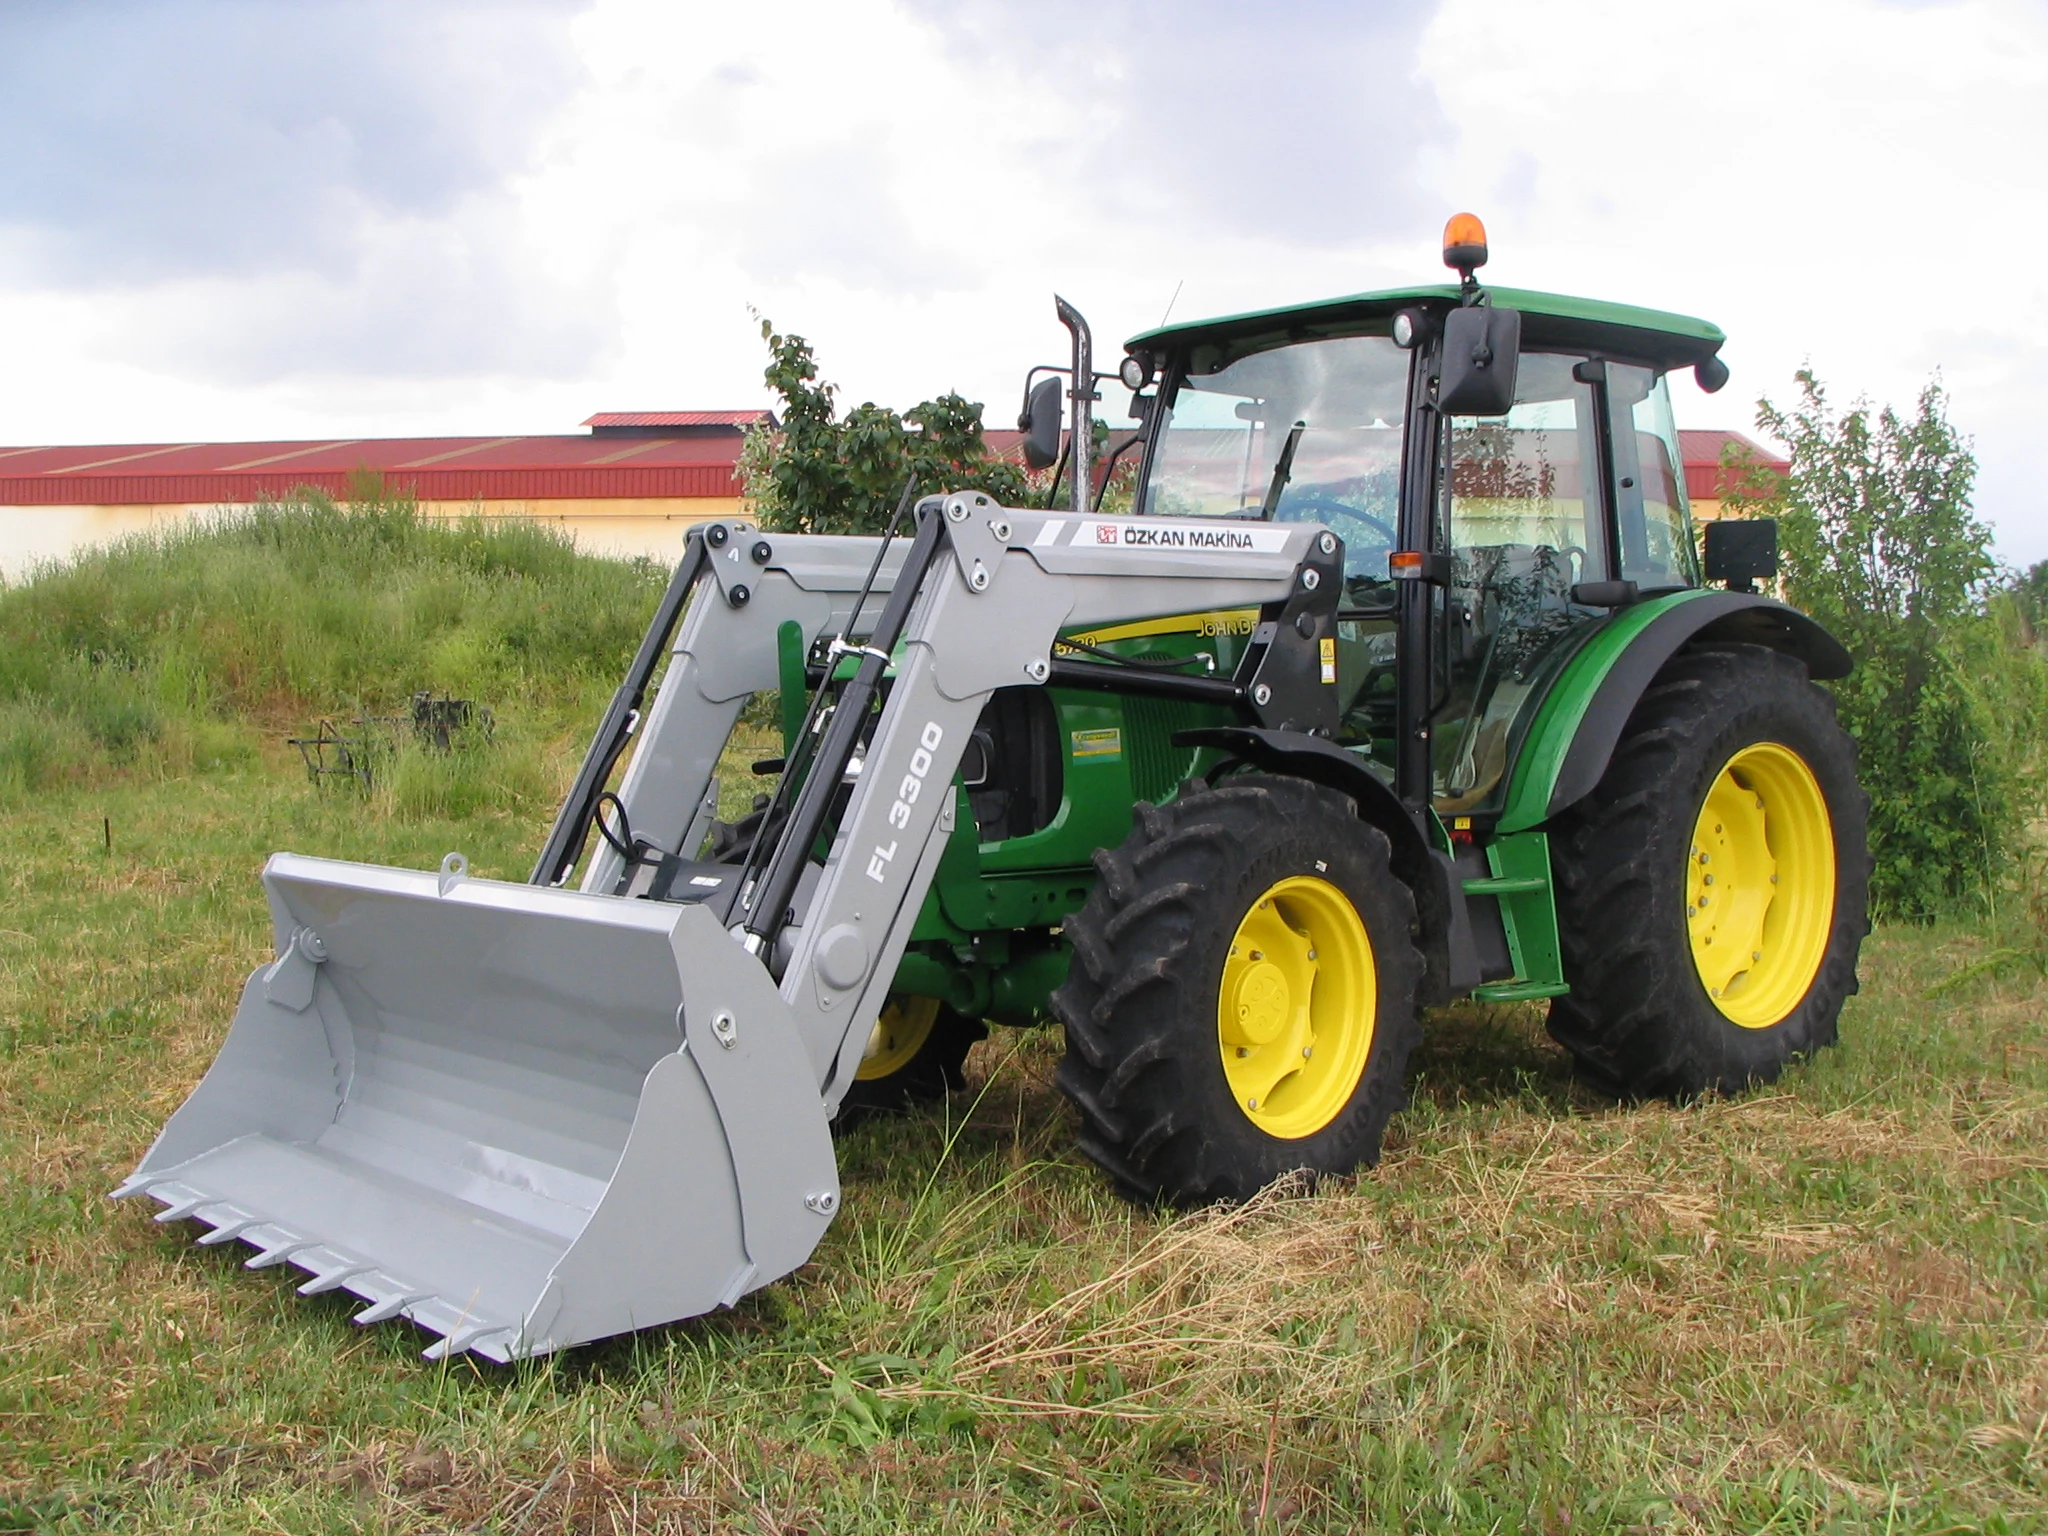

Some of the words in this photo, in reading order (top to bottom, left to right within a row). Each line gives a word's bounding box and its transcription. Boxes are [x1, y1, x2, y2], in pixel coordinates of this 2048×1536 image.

[1124, 526, 1184, 546] ÖZKAN
[1189, 530, 1254, 549] MAKİNA
[1196, 620, 1237, 637] JOHN
[866, 840, 898, 884] FL
[888, 721, 943, 830] 3300
